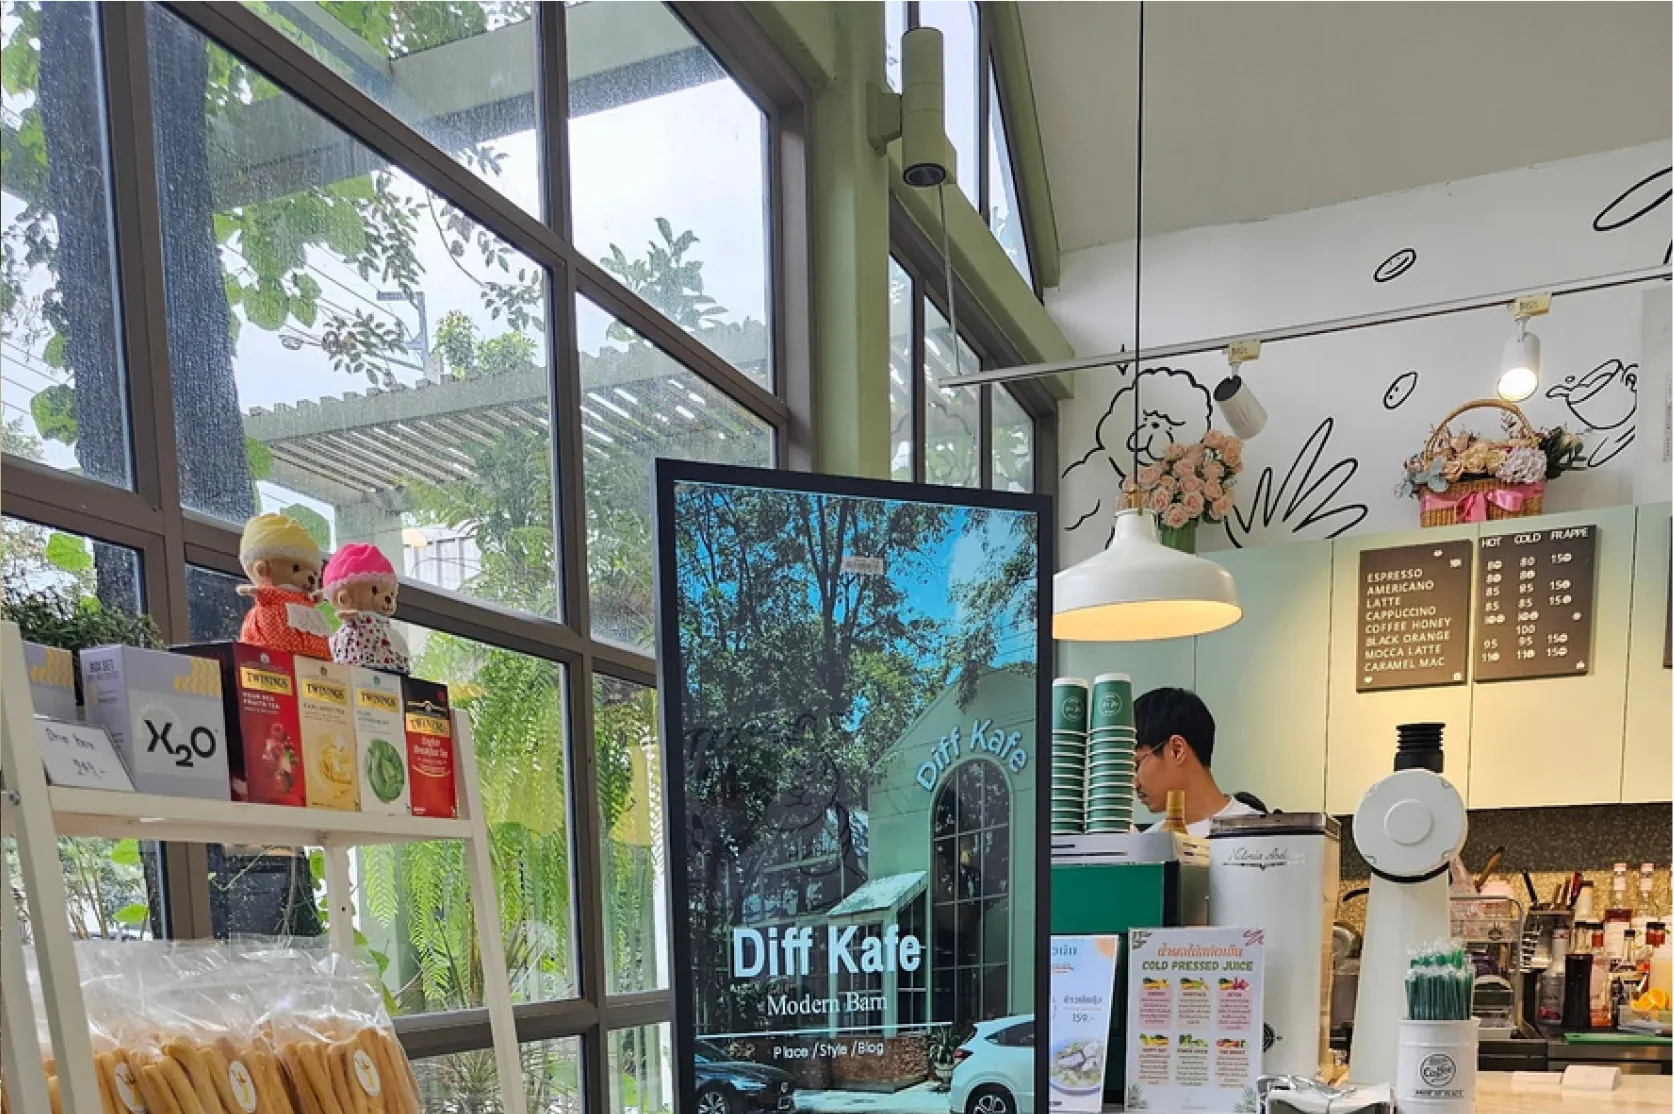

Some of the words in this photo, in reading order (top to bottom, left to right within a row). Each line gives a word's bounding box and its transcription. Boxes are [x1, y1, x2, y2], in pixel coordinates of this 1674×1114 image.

[1481, 537, 1501, 547] HOT
[1514, 533, 1541, 544] COLD
[1550, 527, 1588, 540] FRAPPE
[1367, 569, 1422, 582] ESPRESSO
[1367, 580, 1434, 596] AMERICANO
[1550, 580, 1571, 590] 150
[1366, 596, 1401, 609] LATTE
[1366, 606, 1436, 620] CAPPUCCINO
[1365, 621, 1407, 633] COFFEE
[1412, 618, 1451, 629] HONEY
[1516, 624, 1536, 635] 100
[1366, 635, 1398, 646] BLACK
[1403, 631, 1451, 643] ORANGE
[1365, 648, 1403, 659] MOCCA
[1408, 644, 1441, 656] LATTE
[1364, 660, 1416, 672] CARAMEL
[1419, 658, 1445, 667] MAC
[246, 672, 289, 689] TWININGS
[306, 684, 345, 700] TWININGS
[360, 691, 397, 707] TWININGS
[917, 726, 961, 791] Diff
[969, 719, 1028, 774] Kafe
[733, 926, 813, 978] Diff
[827, 923, 921, 974] Kafe
[1142, 961, 1168, 972] COLD
[1171, 961, 1219, 972] PRESSED
[1222, 961, 1254, 972] JUICE
[767, 993, 841, 1016] Modern
[845, 991, 888, 1012] Barn
[773, 1046, 809, 1059] Place
